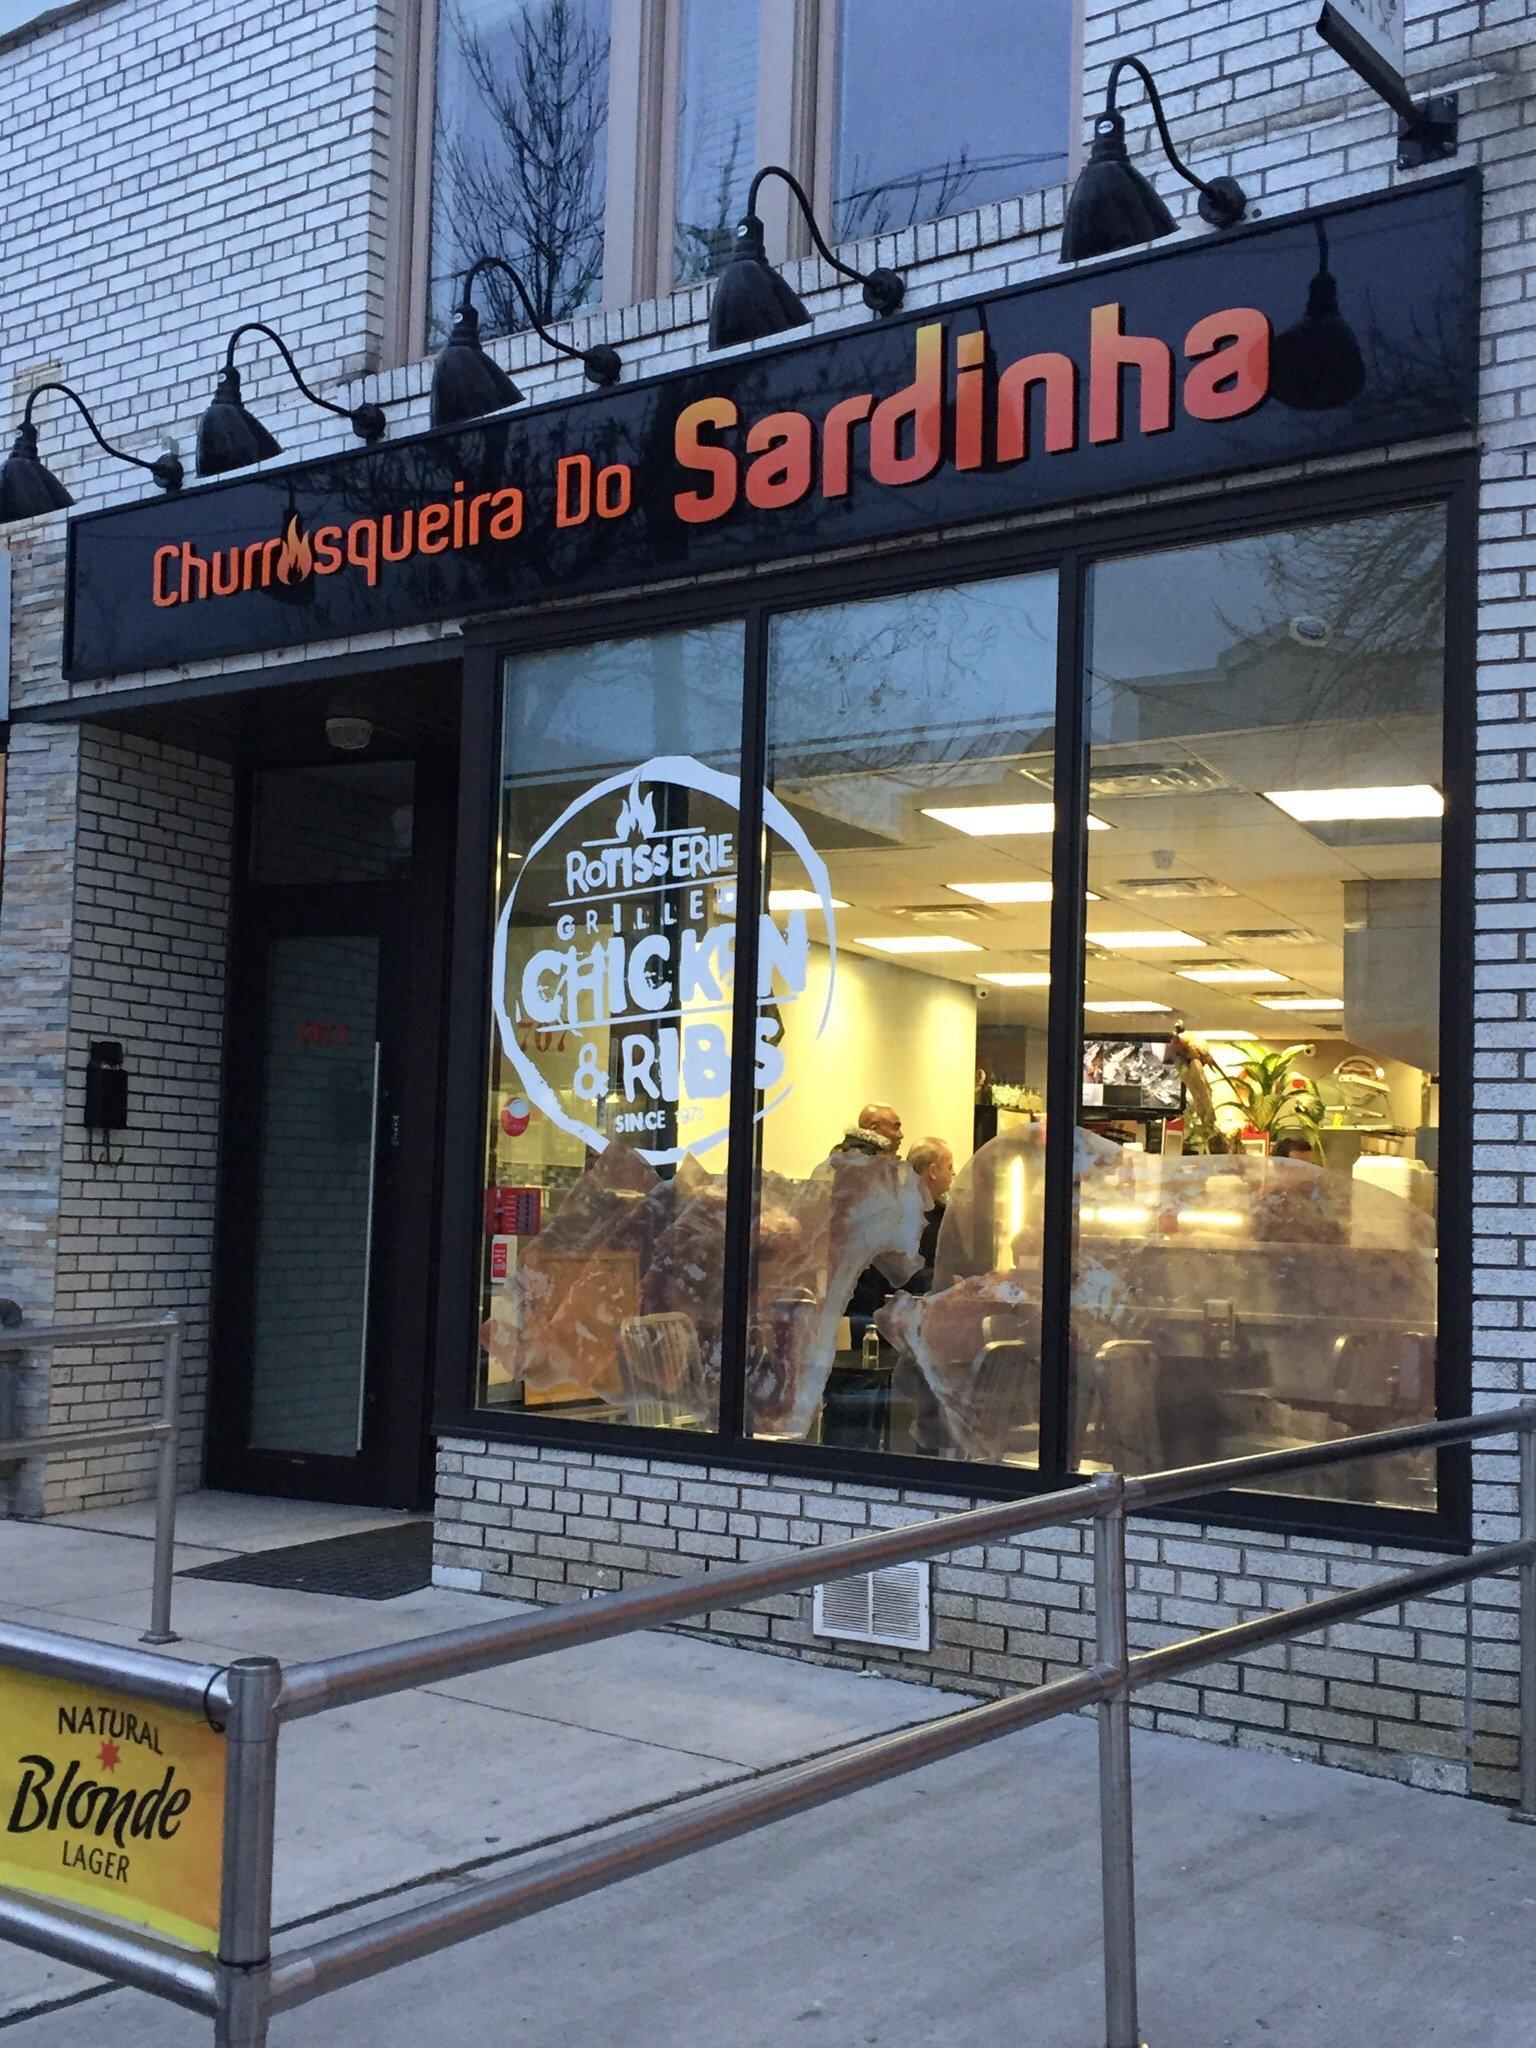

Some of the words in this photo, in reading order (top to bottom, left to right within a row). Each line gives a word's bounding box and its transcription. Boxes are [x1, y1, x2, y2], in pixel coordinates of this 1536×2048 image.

[557, 454, 631, 528] Do
[674, 302, 1270, 523] Sardinha
[573, 1043, 609, 1100] &
[622, 1017, 784, 1103] RIBS
[614, 1109, 666, 1134] SINCE
[58, 1706, 164, 1756] NATURAL
[7, 1754, 192, 1849] Blonde
[61, 1840, 130, 1884] LAGER
